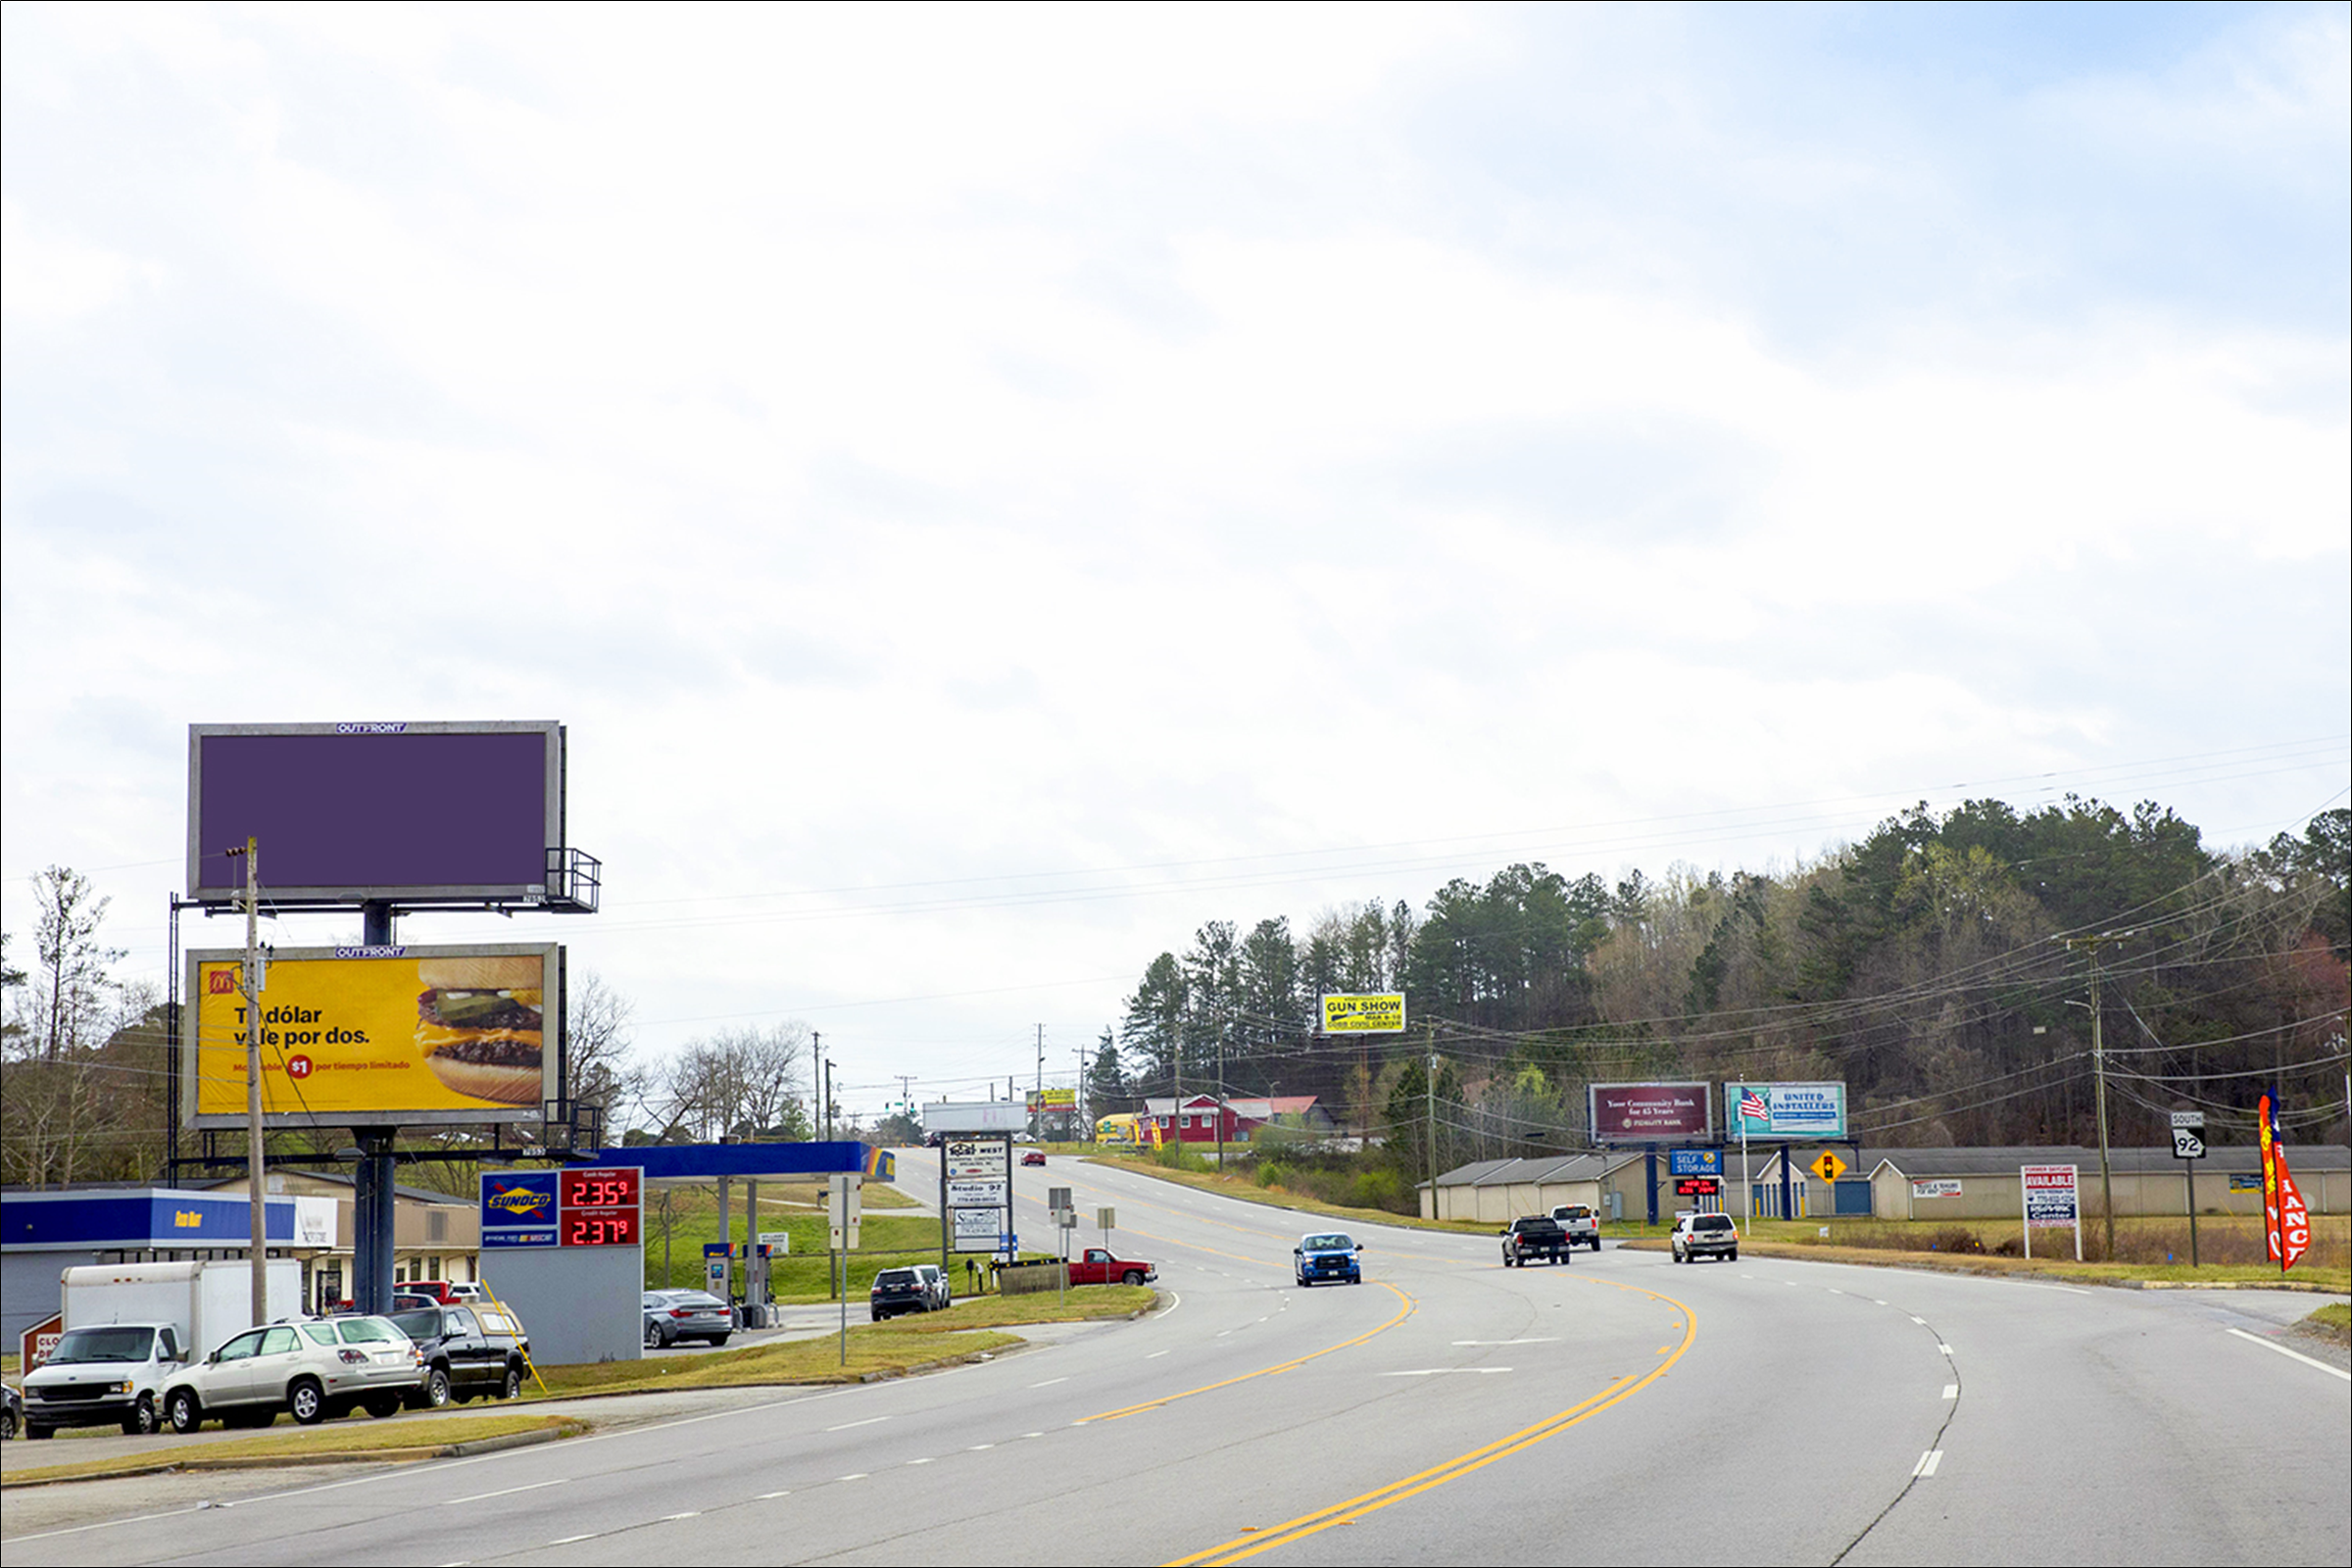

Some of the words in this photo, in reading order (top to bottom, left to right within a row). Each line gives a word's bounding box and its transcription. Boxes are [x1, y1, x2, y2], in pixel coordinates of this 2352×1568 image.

[336, 722, 407, 734] OUTFRONT
[336, 947, 406, 958] OUTFRONT
[1327, 1002, 1356, 1011] GUN
[1360, 1001, 1400, 1011] SHOW
[234, 1007, 260, 1024] T
[266, 1005, 321, 1024] dólar
[234, 1028, 279, 1046] vle
[284, 1031, 321, 1050] por
[325, 1026, 369, 1044] dos.
[292, 1060, 307, 1074] $1
[315, 1063, 331, 1072] por
[333, 1061, 368, 1071] tiempo
[369, 1060, 411, 1069] limitado
[1784, 1093, 1825, 1102] UNITED
[1607, 1100, 1626, 1108] Your
[1627, 1099, 1672, 1108] Community
[2173, 1114, 2202, 1124] SOUTH
[2178, 1137, 2199, 1152] 92
[1677, 1164, 1717, 1173] STORAGE
[2027, 1175, 2074, 1186] AVAILABLE
[492, 1195, 548, 1206] SUNOCO
